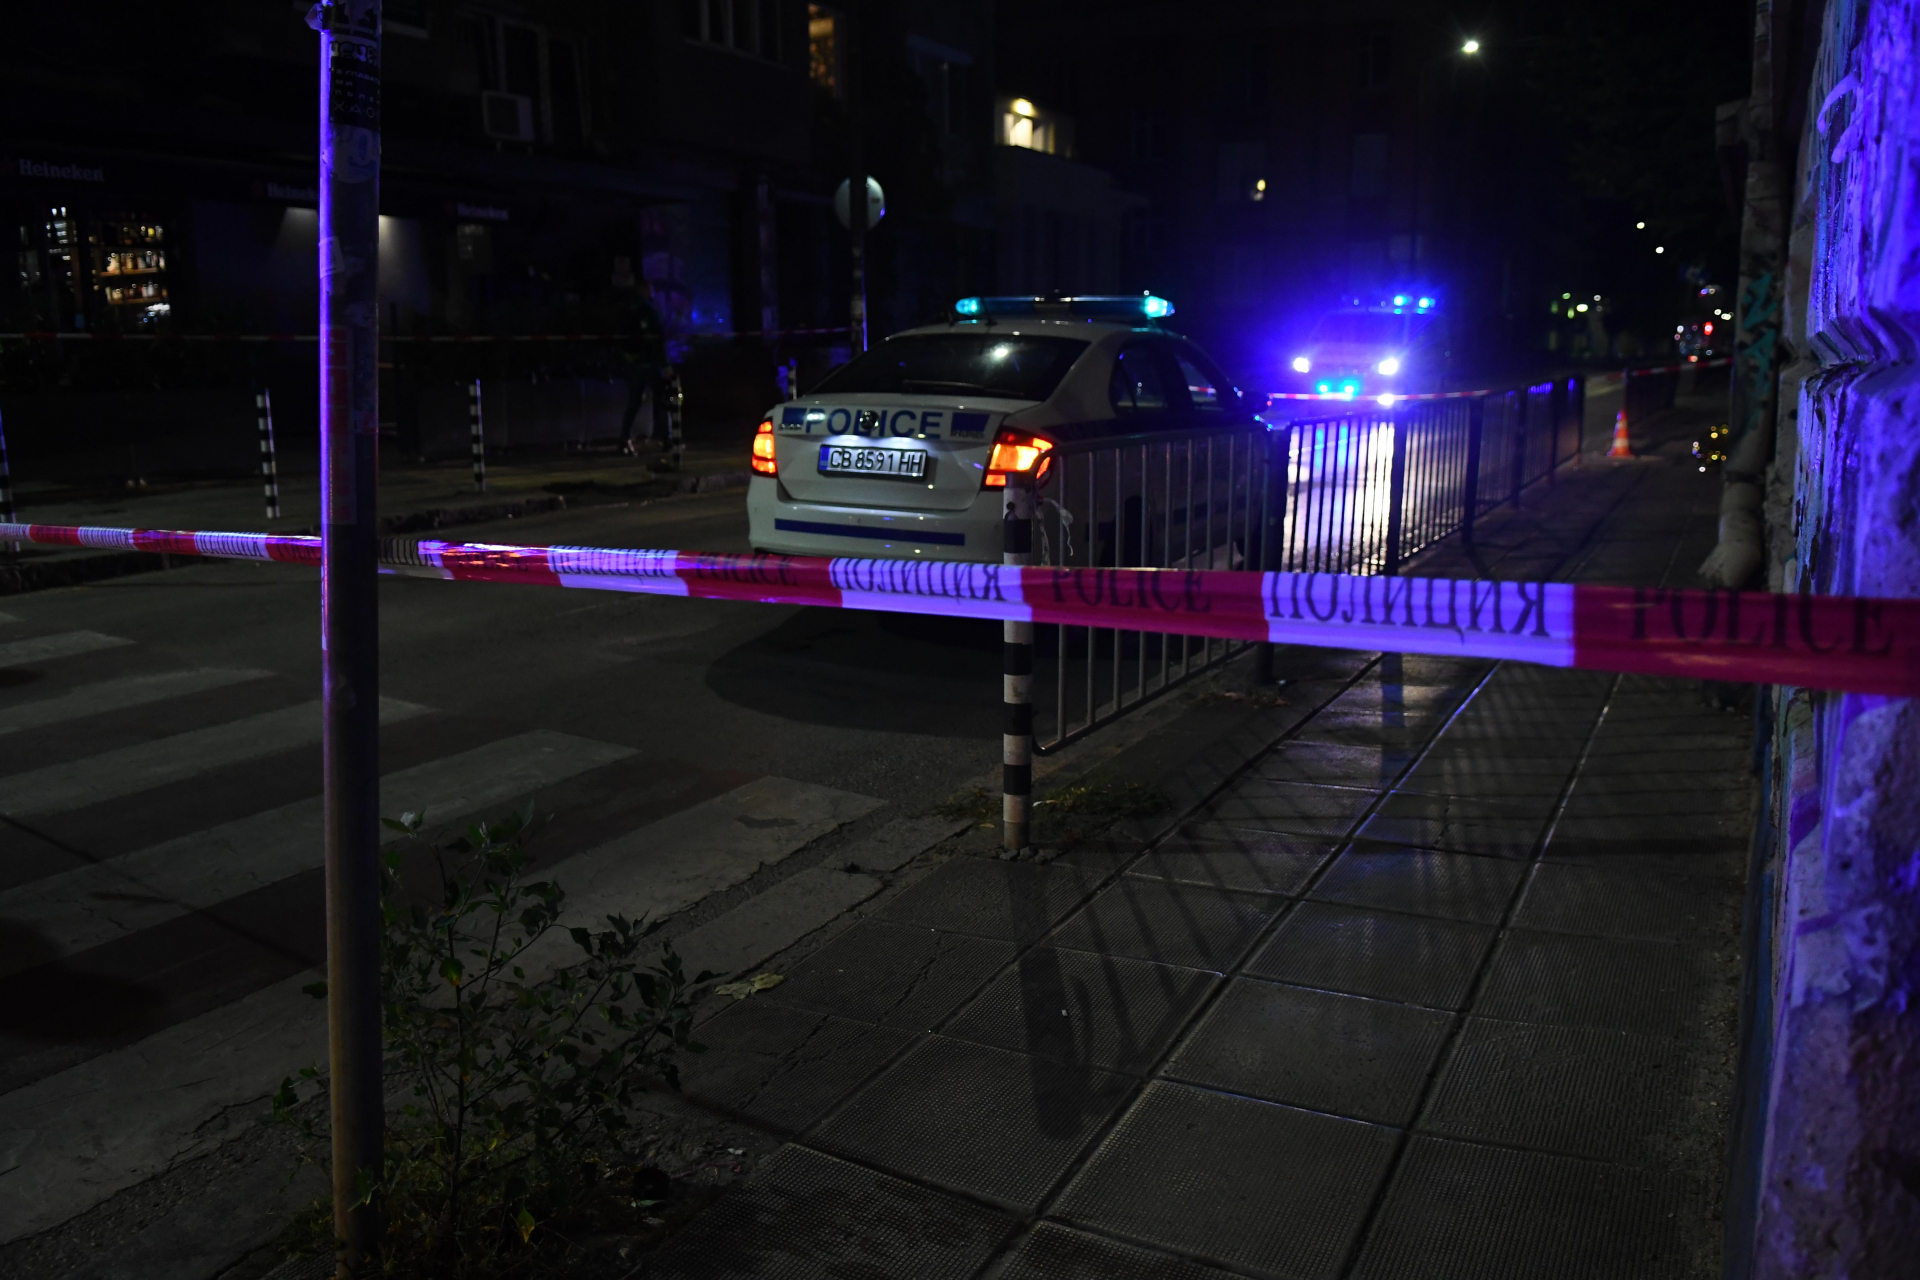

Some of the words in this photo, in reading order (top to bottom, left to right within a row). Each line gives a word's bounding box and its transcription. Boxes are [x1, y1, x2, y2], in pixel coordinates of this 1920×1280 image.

[18, 158, 105, 183] Heineken
[806, 408, 943, 439] POLICE
[831, 449, 852, 468] CB
[855, 450, 894, 471] 8591
[898, 451, 923, 473] HH
[829, 557, 1005, 605] ПОЛИЦИЯ
[1051, 570, 1214, 613] POLICE
[1268, 572, 1551, 644] ПОЛИЦИЯ
[1632, 588, 1894, 657] POLICE
